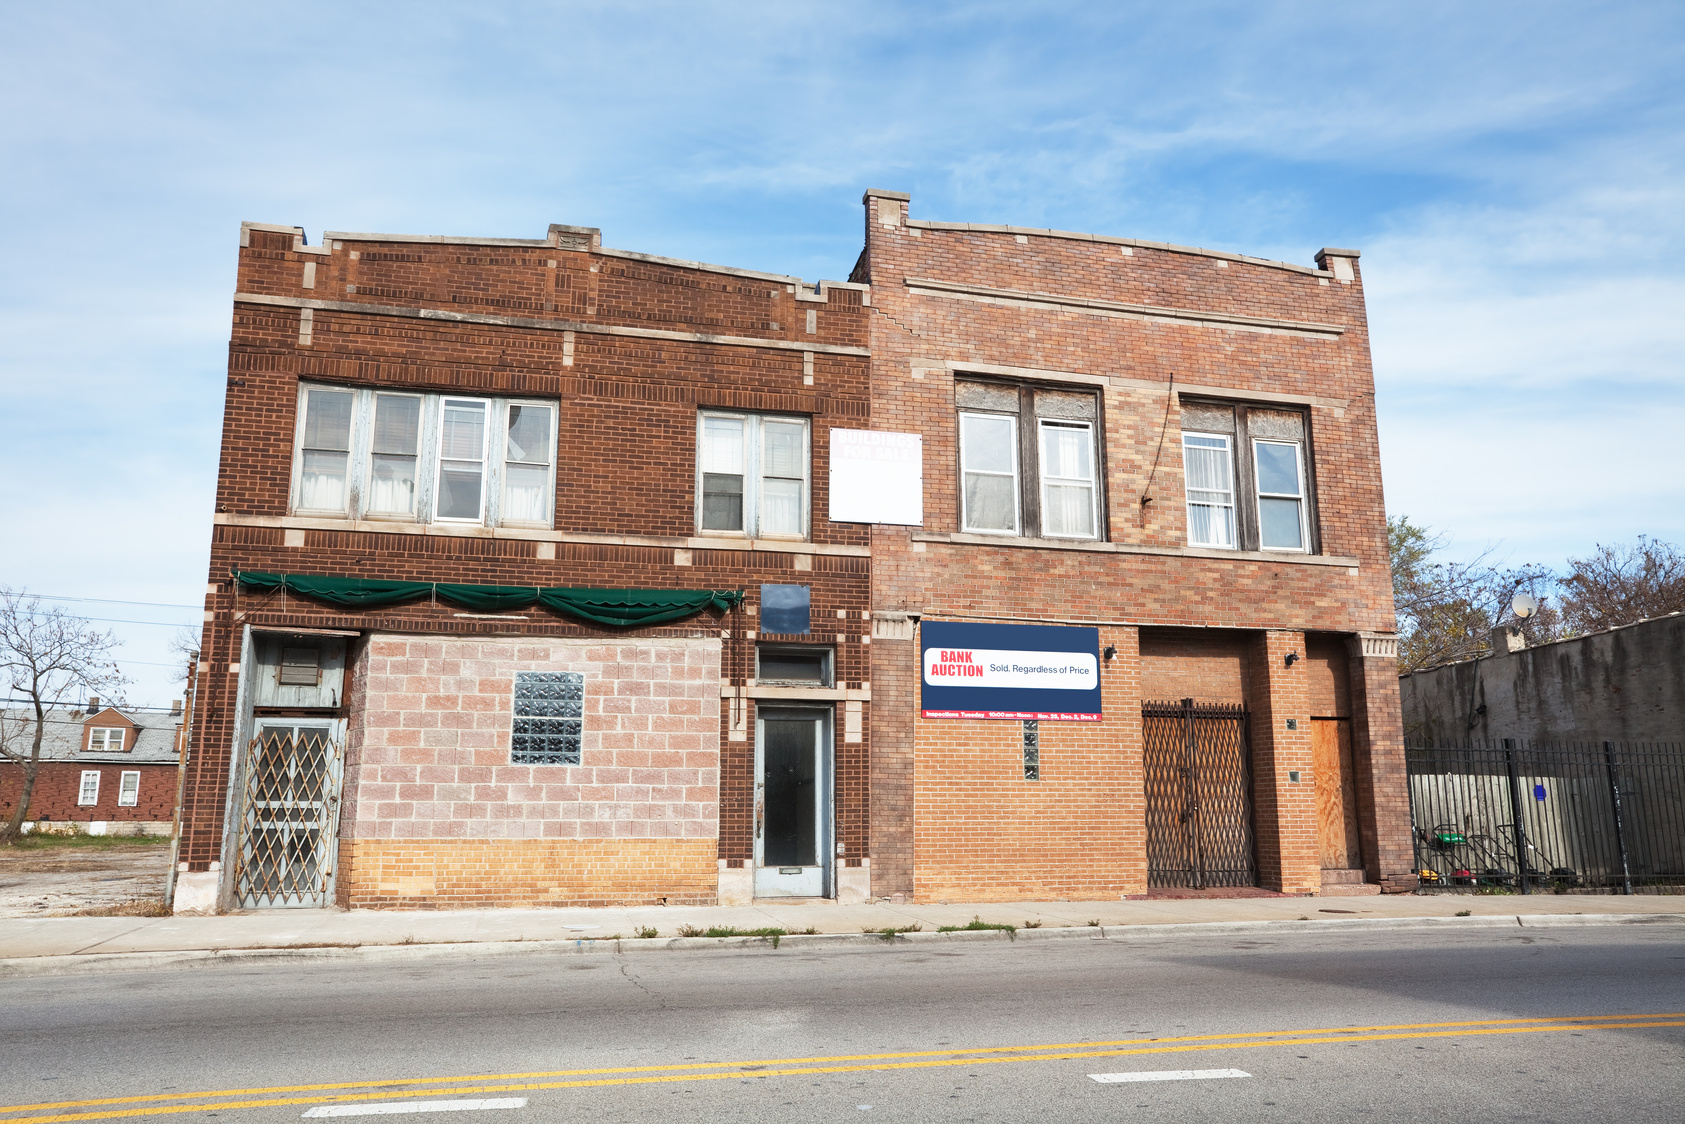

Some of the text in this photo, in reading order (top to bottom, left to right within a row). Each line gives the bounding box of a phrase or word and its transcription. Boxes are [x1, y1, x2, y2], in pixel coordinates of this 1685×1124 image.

[838, 431, 914, 448] BUILDINGS
[844, 445, 909, 462] FOR SALE
[940, 650, 973, 664] BANK
[931, 664, 983, 677] AUCTION
[1012, 665, 1057, 674] Regardless
[1059, 666, 1067, 674] of
